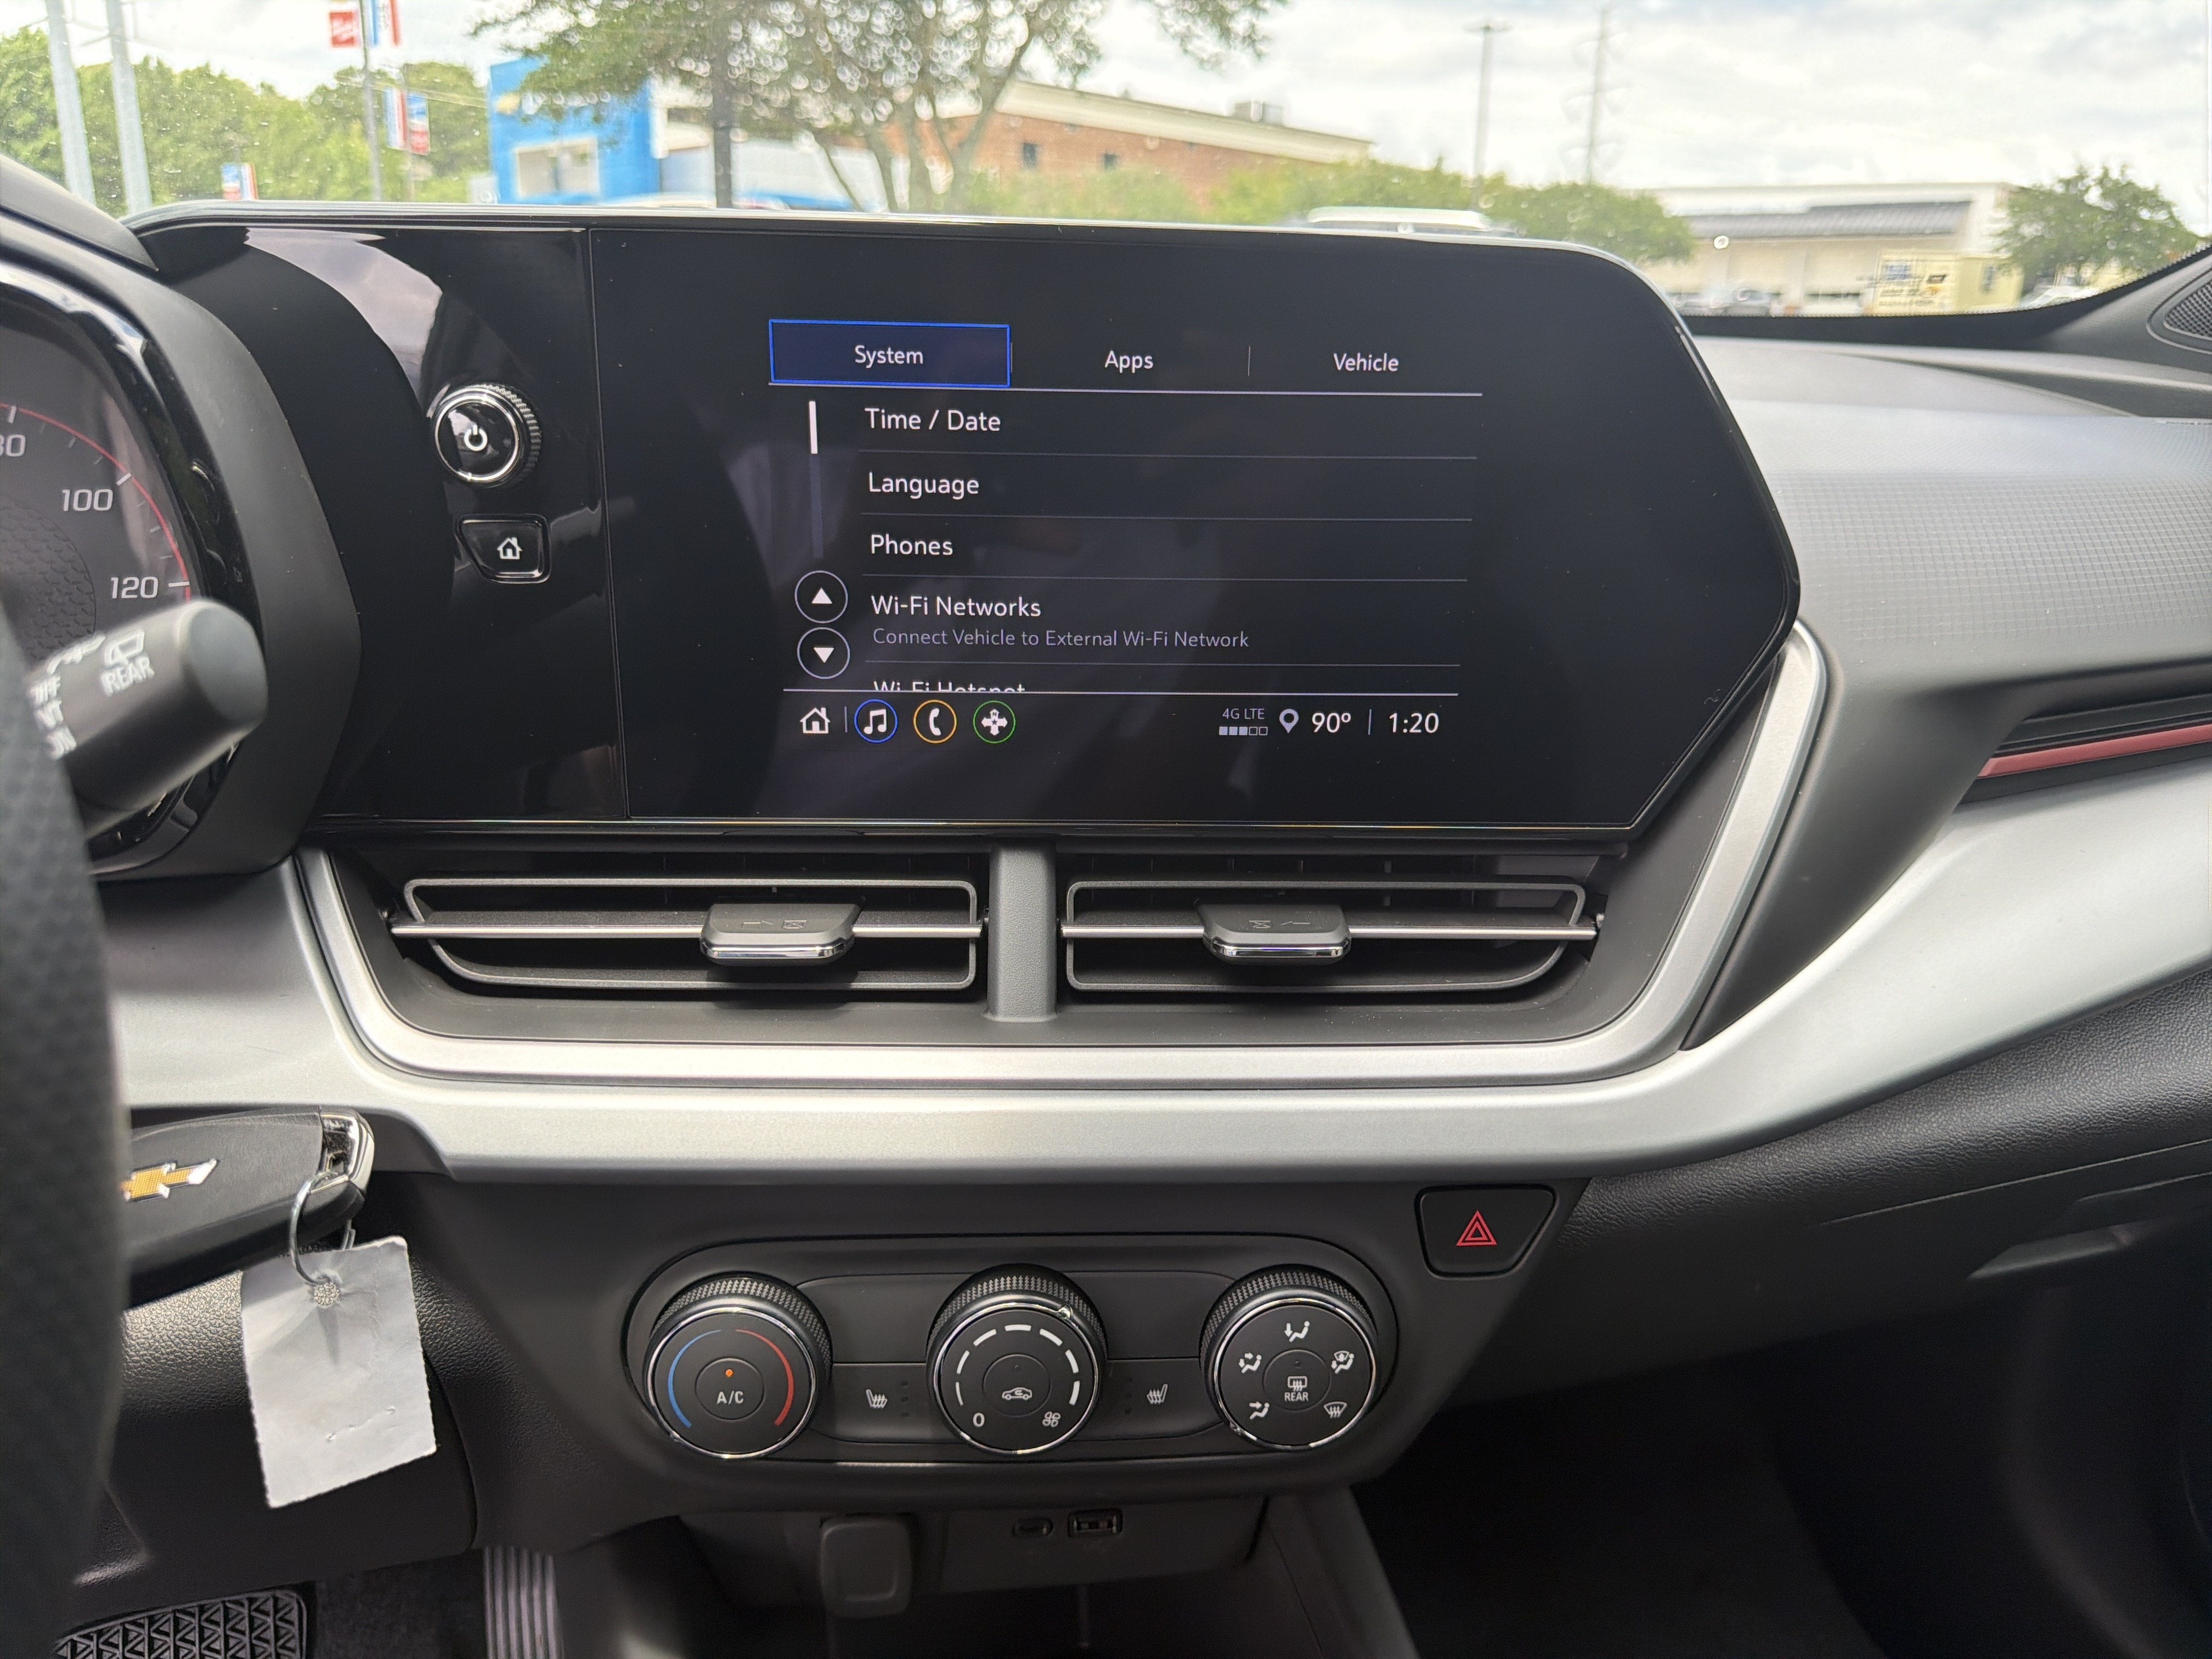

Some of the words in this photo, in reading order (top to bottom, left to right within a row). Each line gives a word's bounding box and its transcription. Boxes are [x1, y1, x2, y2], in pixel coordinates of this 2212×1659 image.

[854, 344, 924, 369] System
[1104, 349, 1154, 374] Apps
[1333, 352, 1400, 373] Vehicle
[864, 407, 922, 430] Time
[928, 409, 940, 431] /
[947, 409, 1001, 432] Date
[0, 434, 26, 457] 0
[868, 471, 980, 501] Language
[61, 488, 114, 511] 100
[871, 533, 953, 556] Phones
[110, 576, 159, 599] 120
[870, 595, 929, 616] Wi-Fi
[935, 595, 1042, 617] Networks
[873, 627, 948, 646] Connect
[952, 628, 1016, 646] Vehicle
[1020, 630, 1040, 647] to
[1045, 629, 1118, 647] External
[1122, 630, 1169, 647] Wi-Fi
[1174, 630, 1250, 648] Network
[100, 655, 155, 697] REAR
[1221, 707, 1240, 720] 4G
[1244, 708, 1266, 720] LTE
[1389, 712, 1440, 734] 1:20
[716, 1390, 744, 1405] A/C
[1284, 1391, 1310, 1402] REAR
